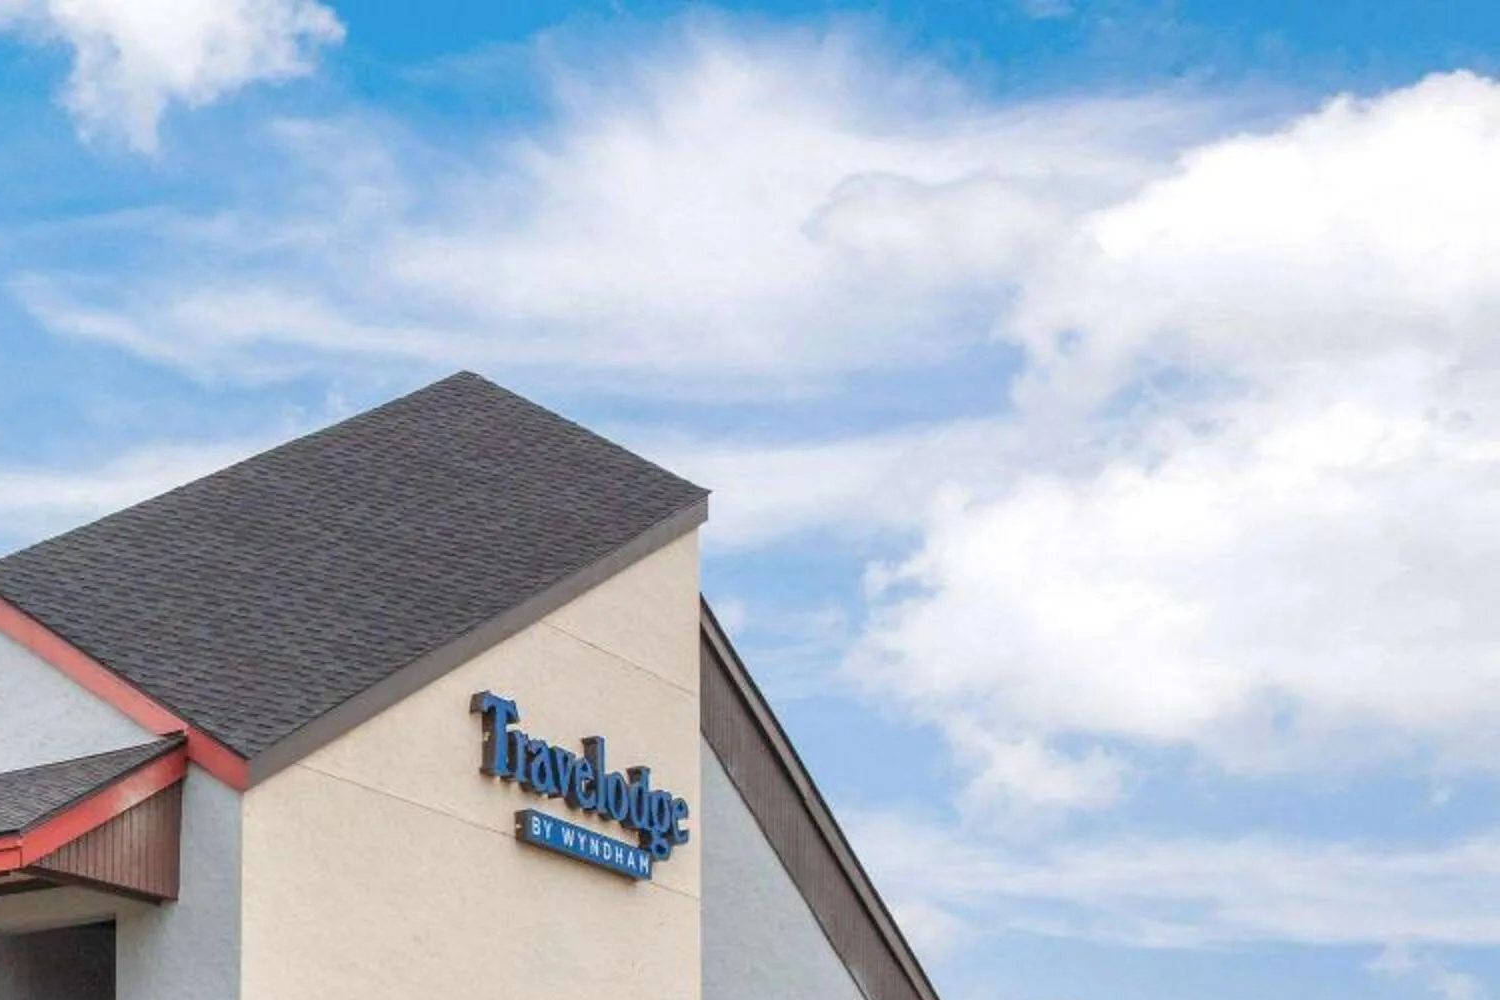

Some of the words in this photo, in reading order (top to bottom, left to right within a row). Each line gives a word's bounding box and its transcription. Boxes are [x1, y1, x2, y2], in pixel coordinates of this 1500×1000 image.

[470, 691, 689, 861] Travelodge
[531, 816, 552, 840] BY
[561, 827, 650, 874] WYNDHAM
